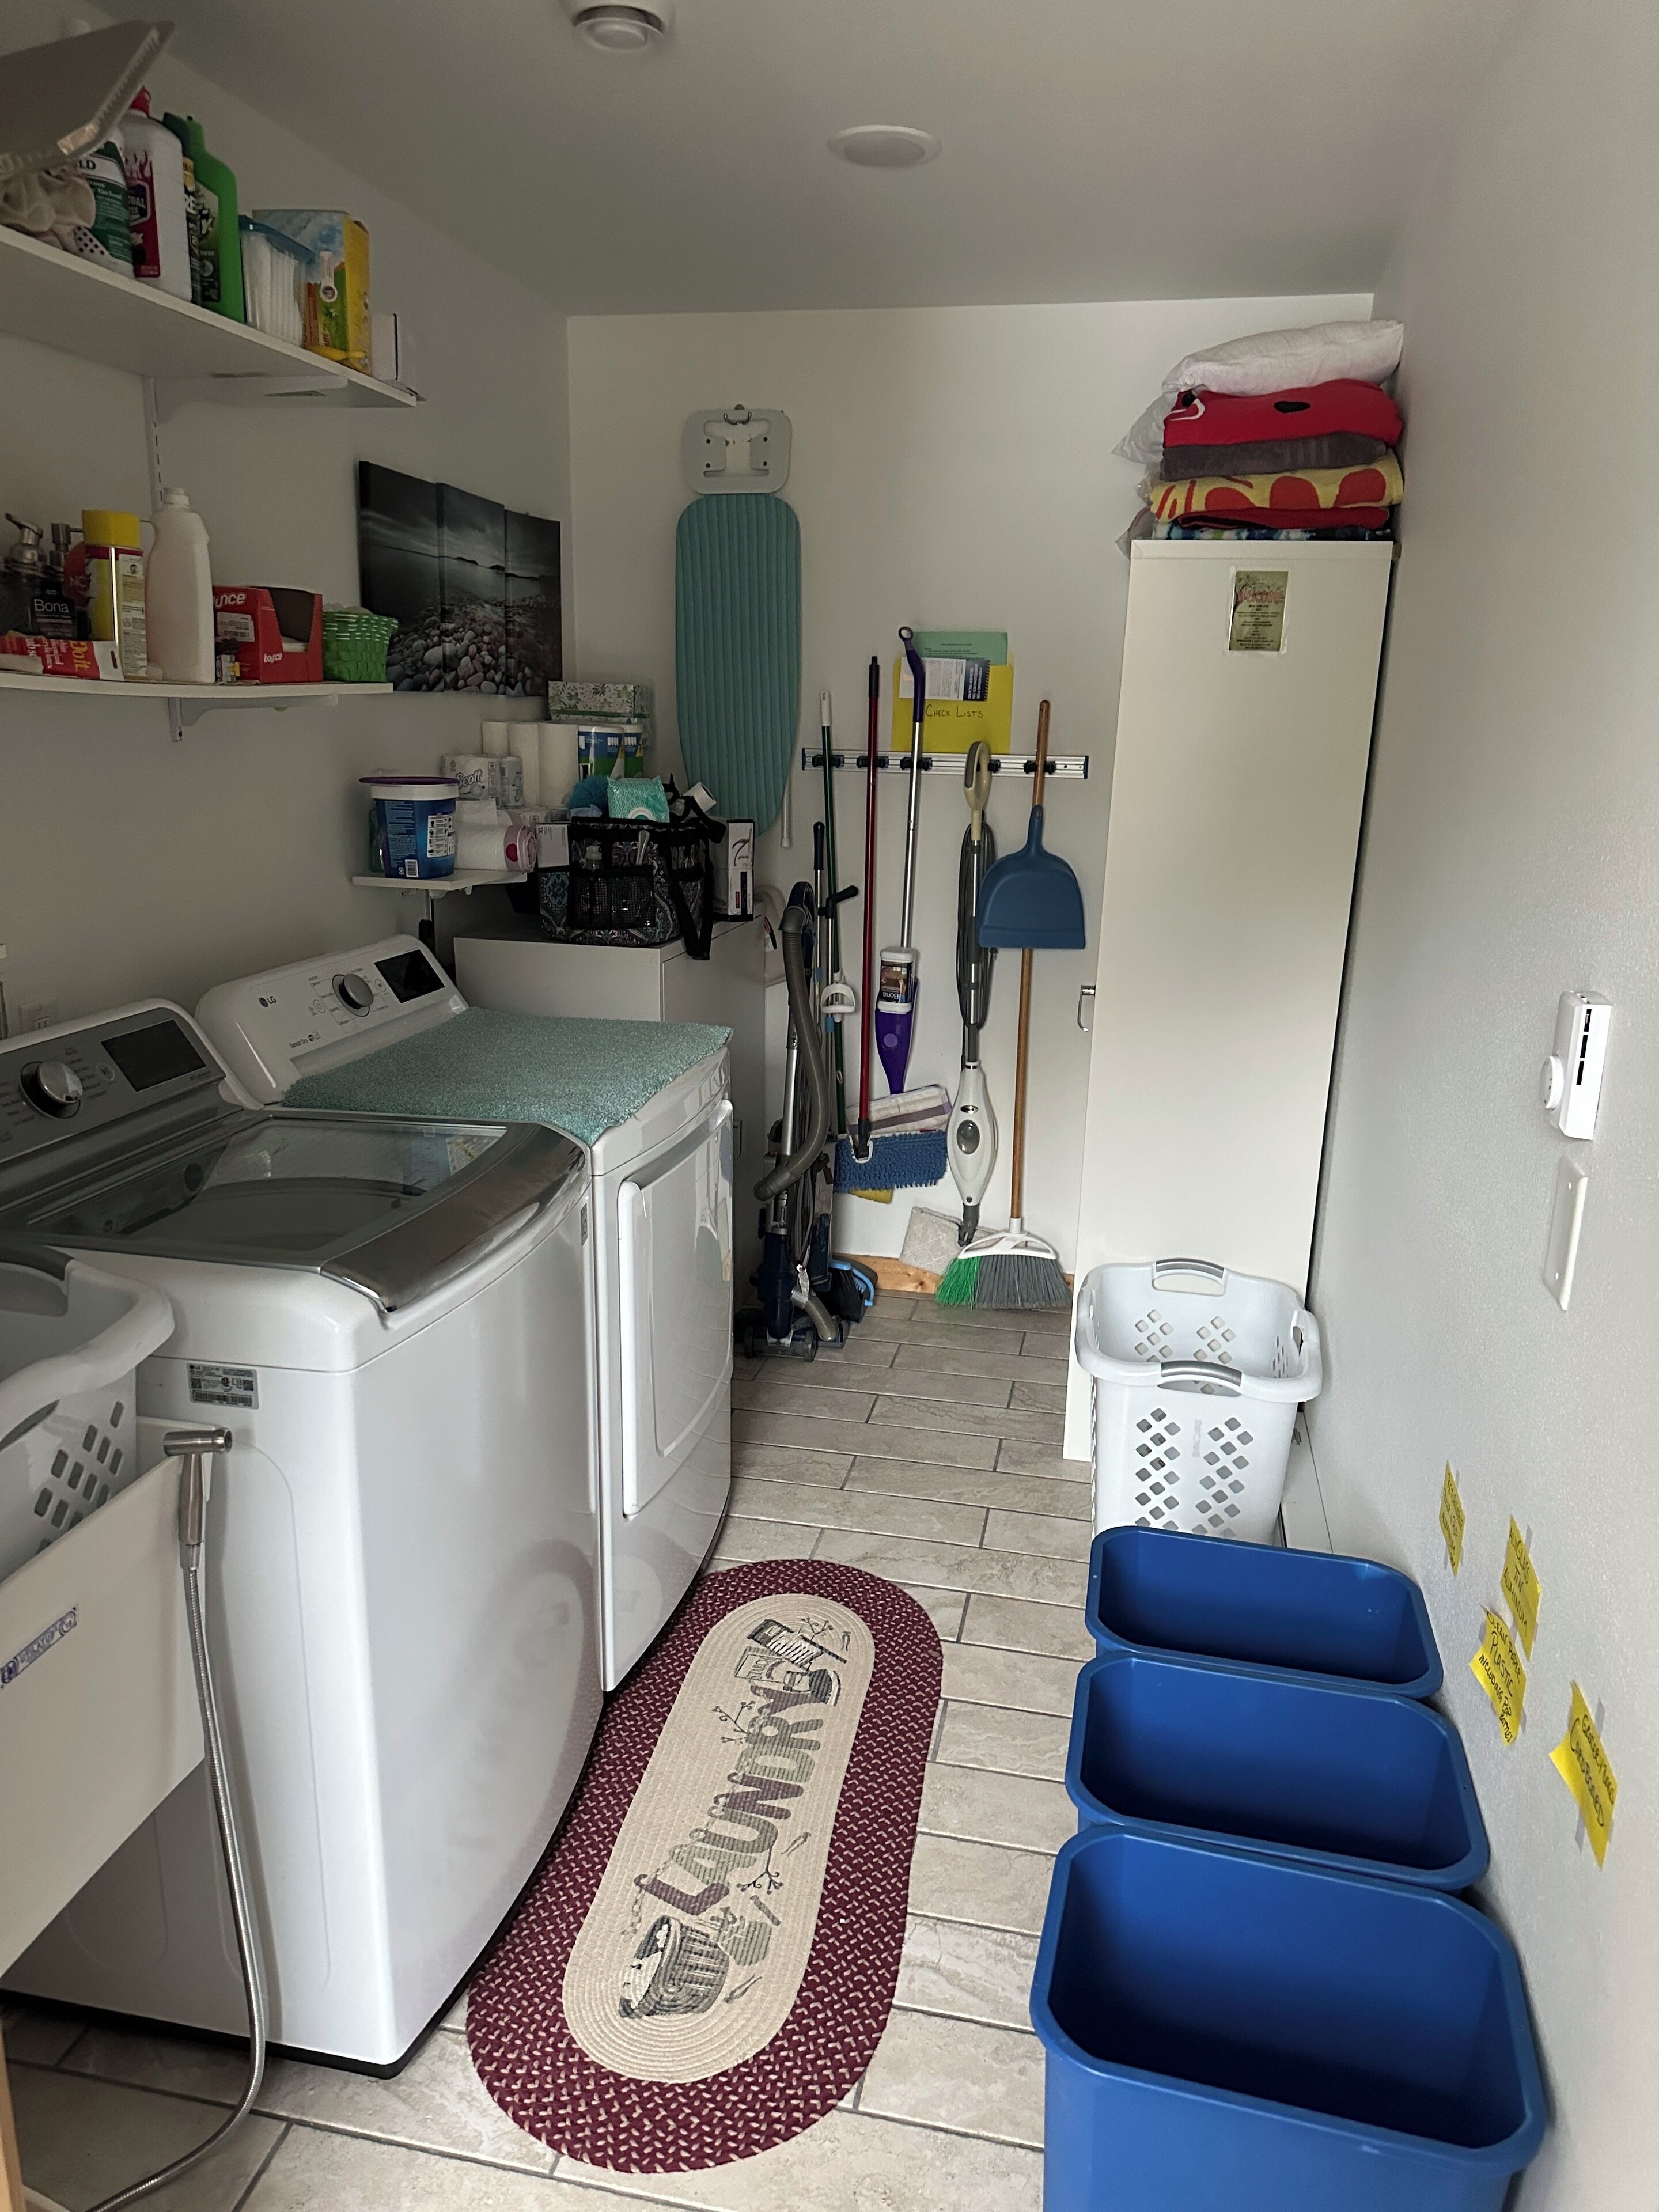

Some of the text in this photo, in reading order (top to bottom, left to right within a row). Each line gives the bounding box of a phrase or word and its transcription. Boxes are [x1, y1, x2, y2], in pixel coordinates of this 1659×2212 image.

[34, 599, 69, 613] Bona
[214, 593, 247, 609] unce
[264, 653, 283, 664] bounce
[456, 769, 483, 790] Scott
[267, 995, 277, 1004] LG
[882, 991, 899, 1000] Bona
[1490, 1631, 1513, 1697] PLASTIC
[1479, 1654, 1503, 1703] INCLUDING
[634, 1683, 824, 1915] LAUNDRY
